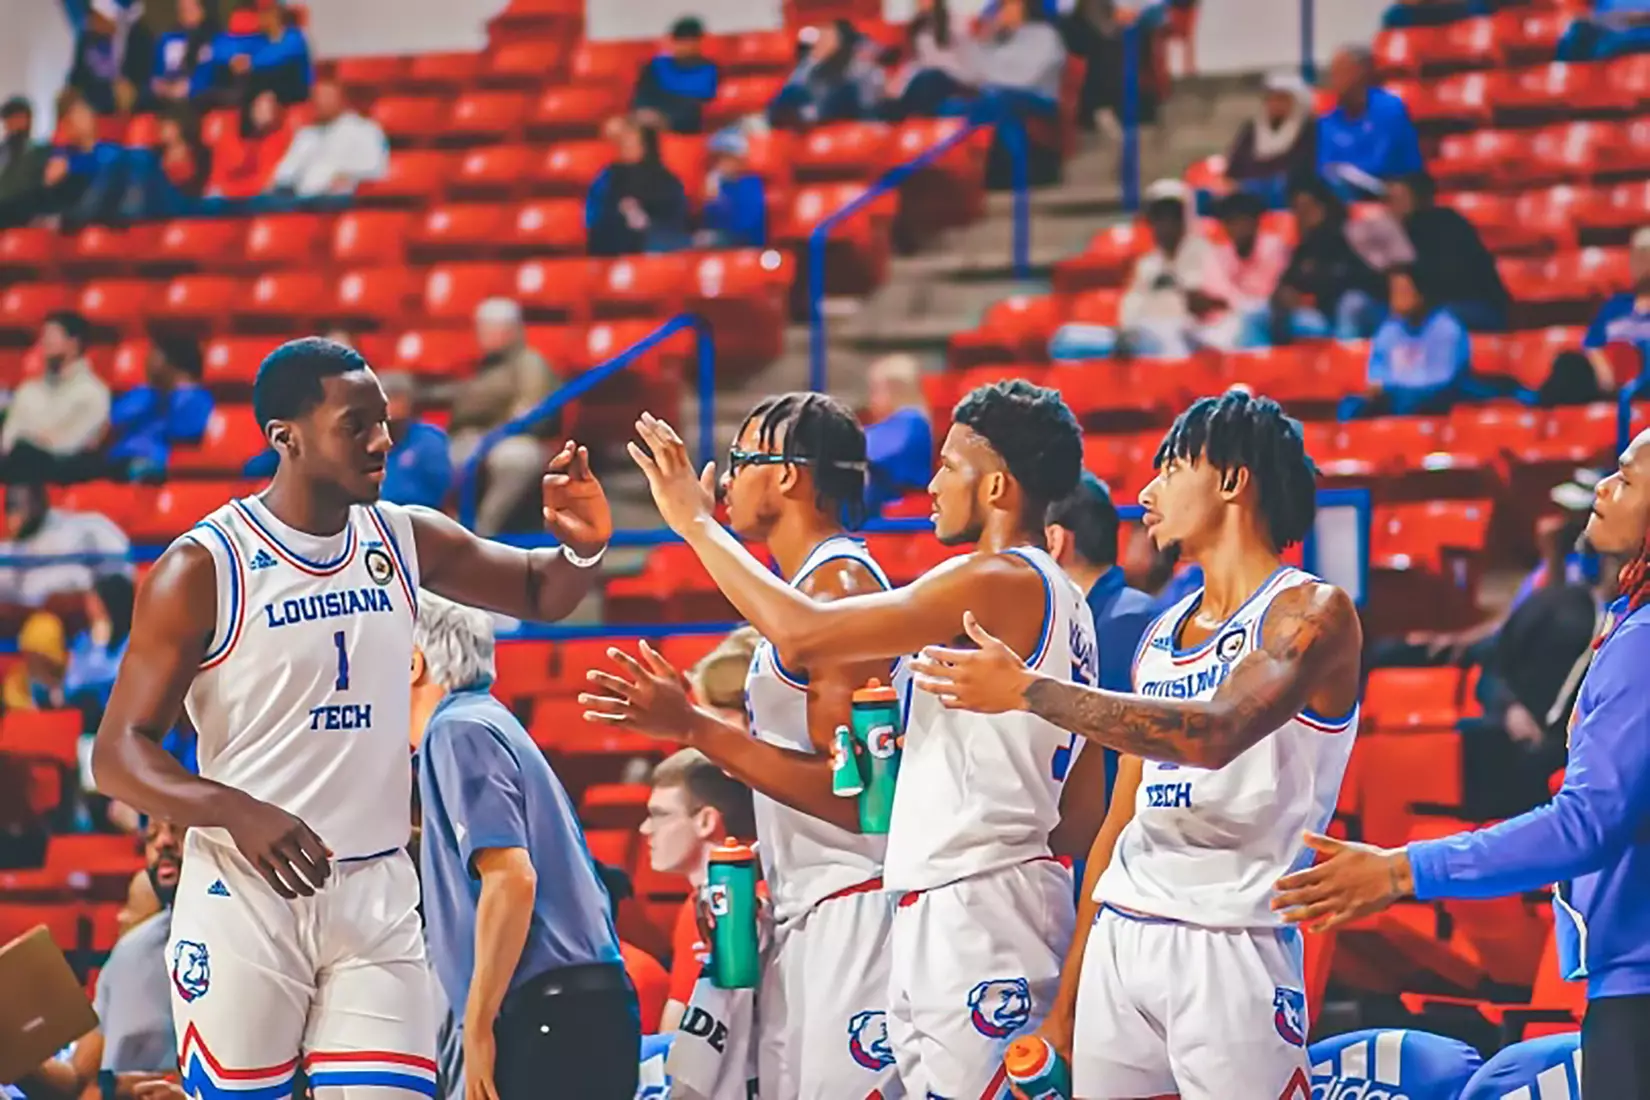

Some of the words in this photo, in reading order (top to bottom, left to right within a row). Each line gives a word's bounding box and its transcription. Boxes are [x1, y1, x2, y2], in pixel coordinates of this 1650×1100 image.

[265, 588, 393, 627] LOUISIANA
[334, 631, 349, 691] 1
[310, 704, 371, 730] TECH
[867, 725, 895, 759] G
[1146, 782, 1192, 808] TECH
